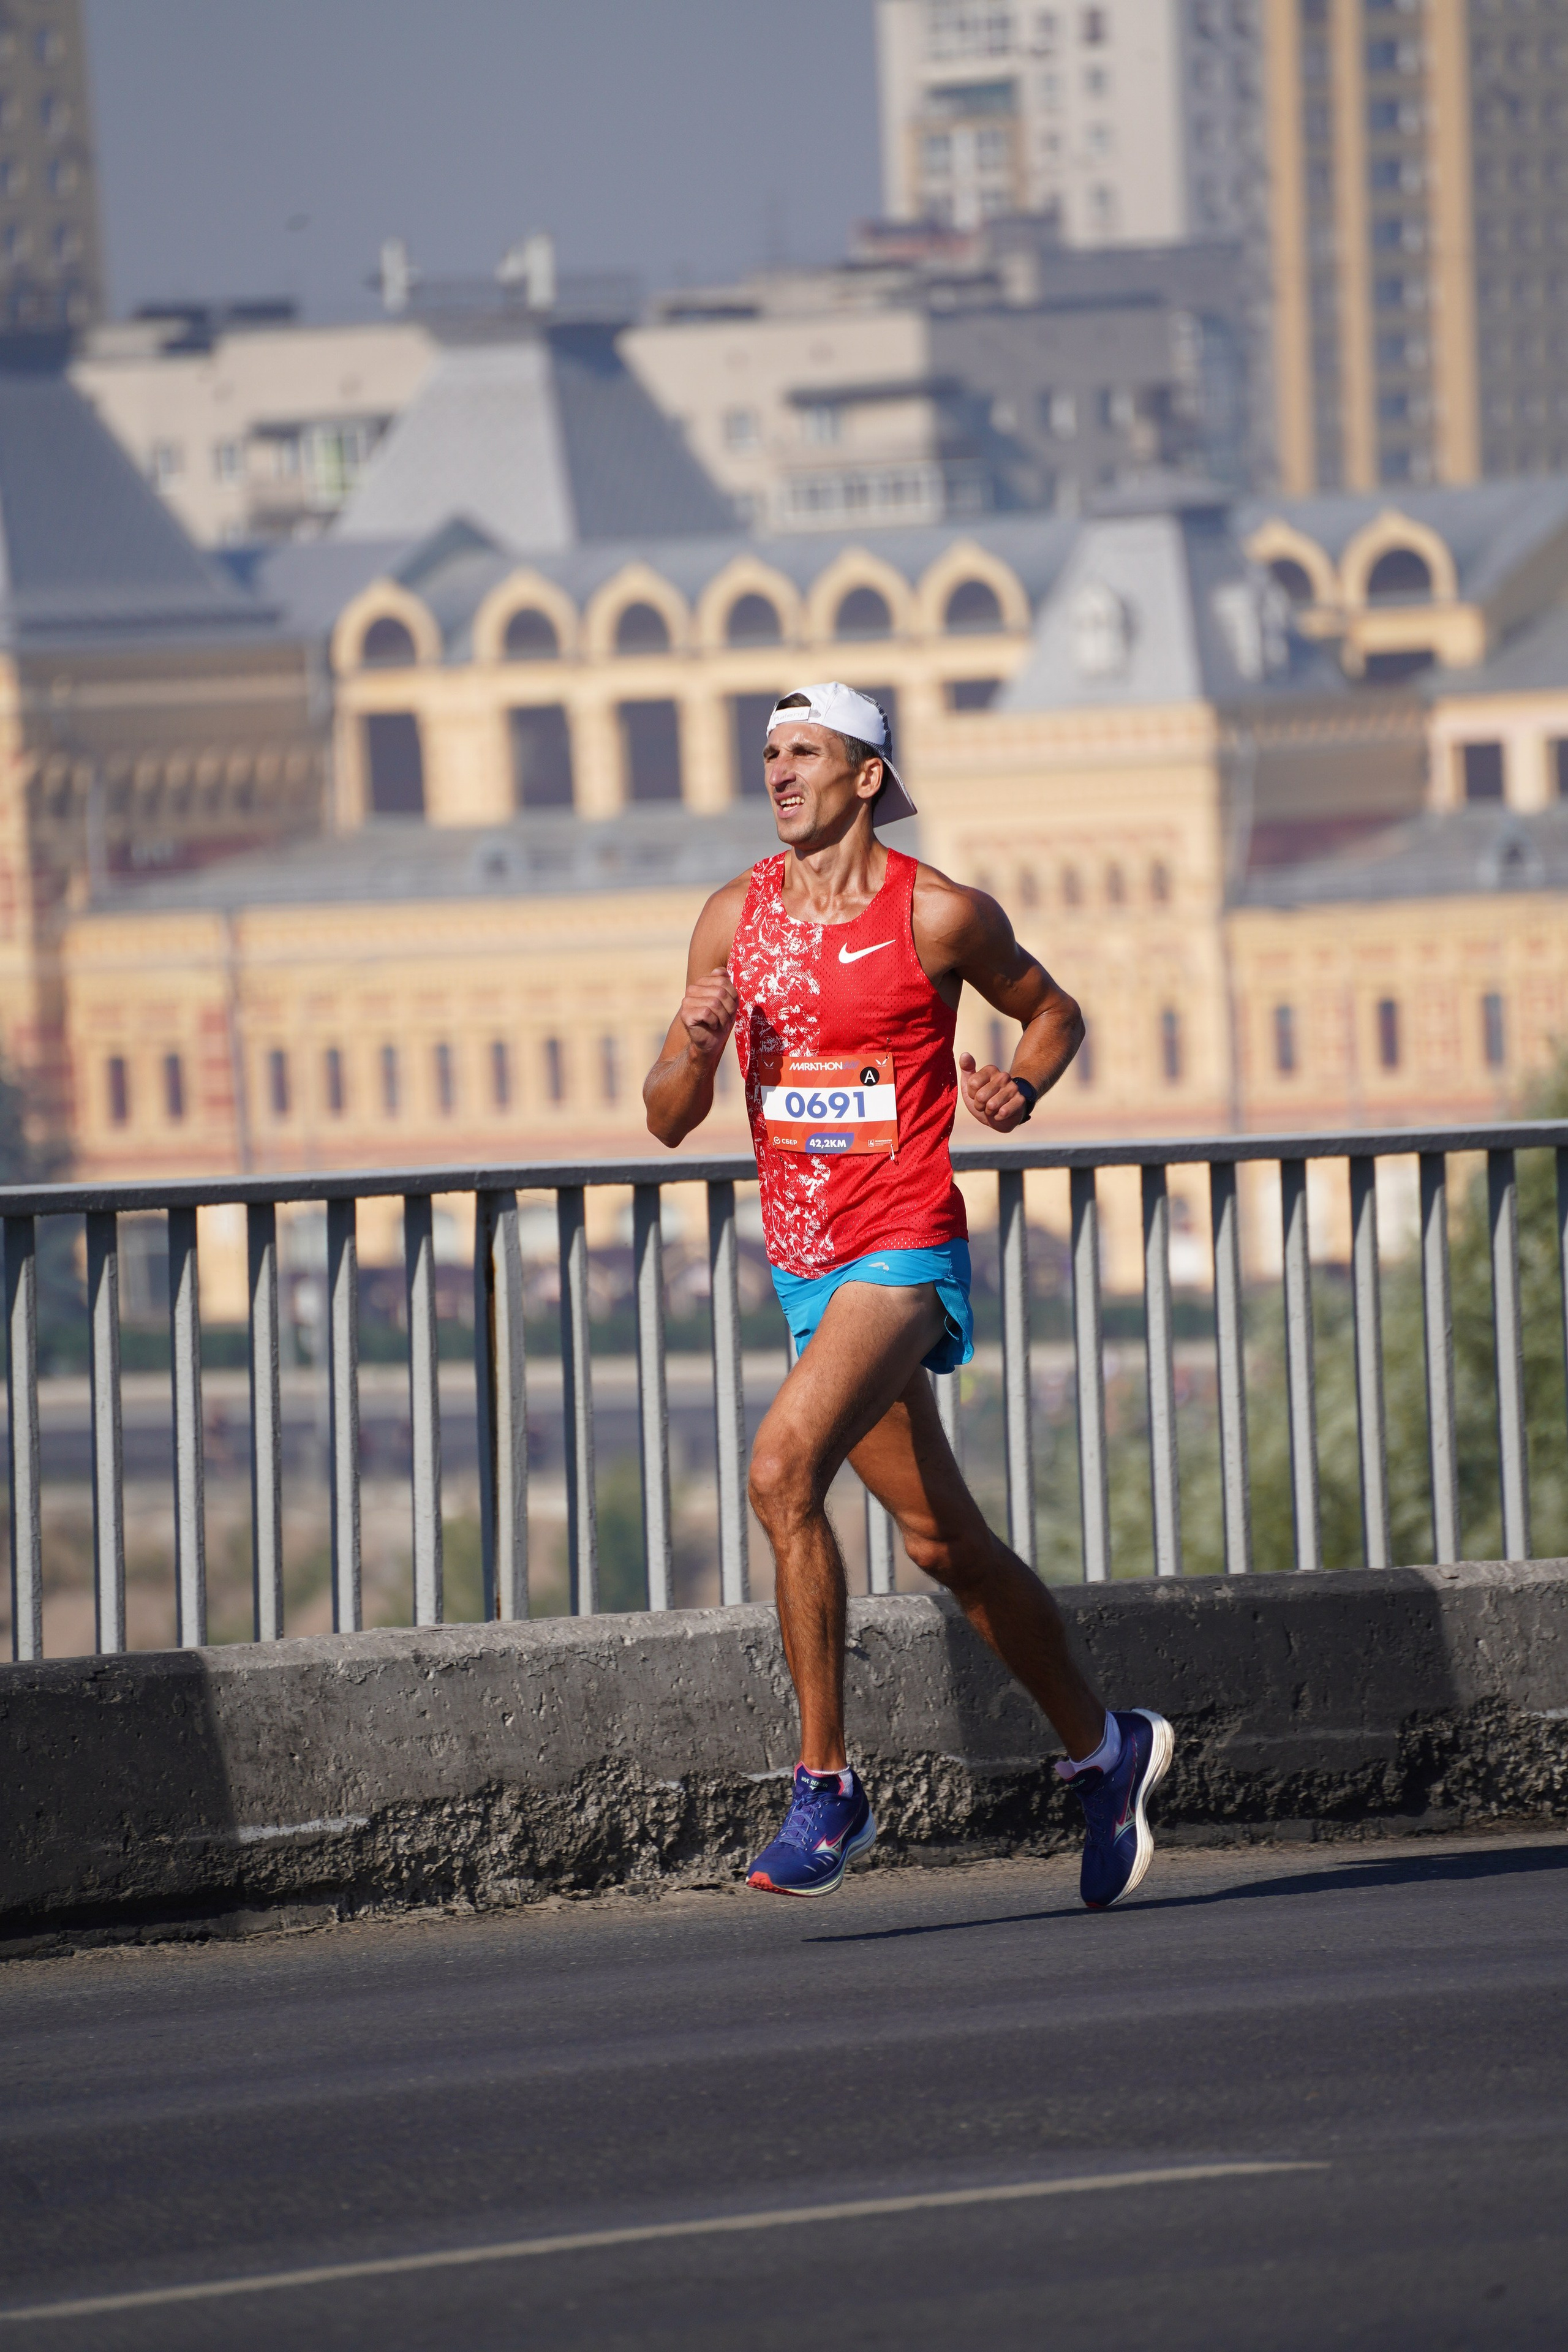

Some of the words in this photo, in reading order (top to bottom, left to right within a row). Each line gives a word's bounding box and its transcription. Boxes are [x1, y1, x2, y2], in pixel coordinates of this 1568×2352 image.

[789, 1061, 843, 1071] MARATHON
[864, 1070, 876, 1084] A
[785, 1091, 865, 1119] 0691
